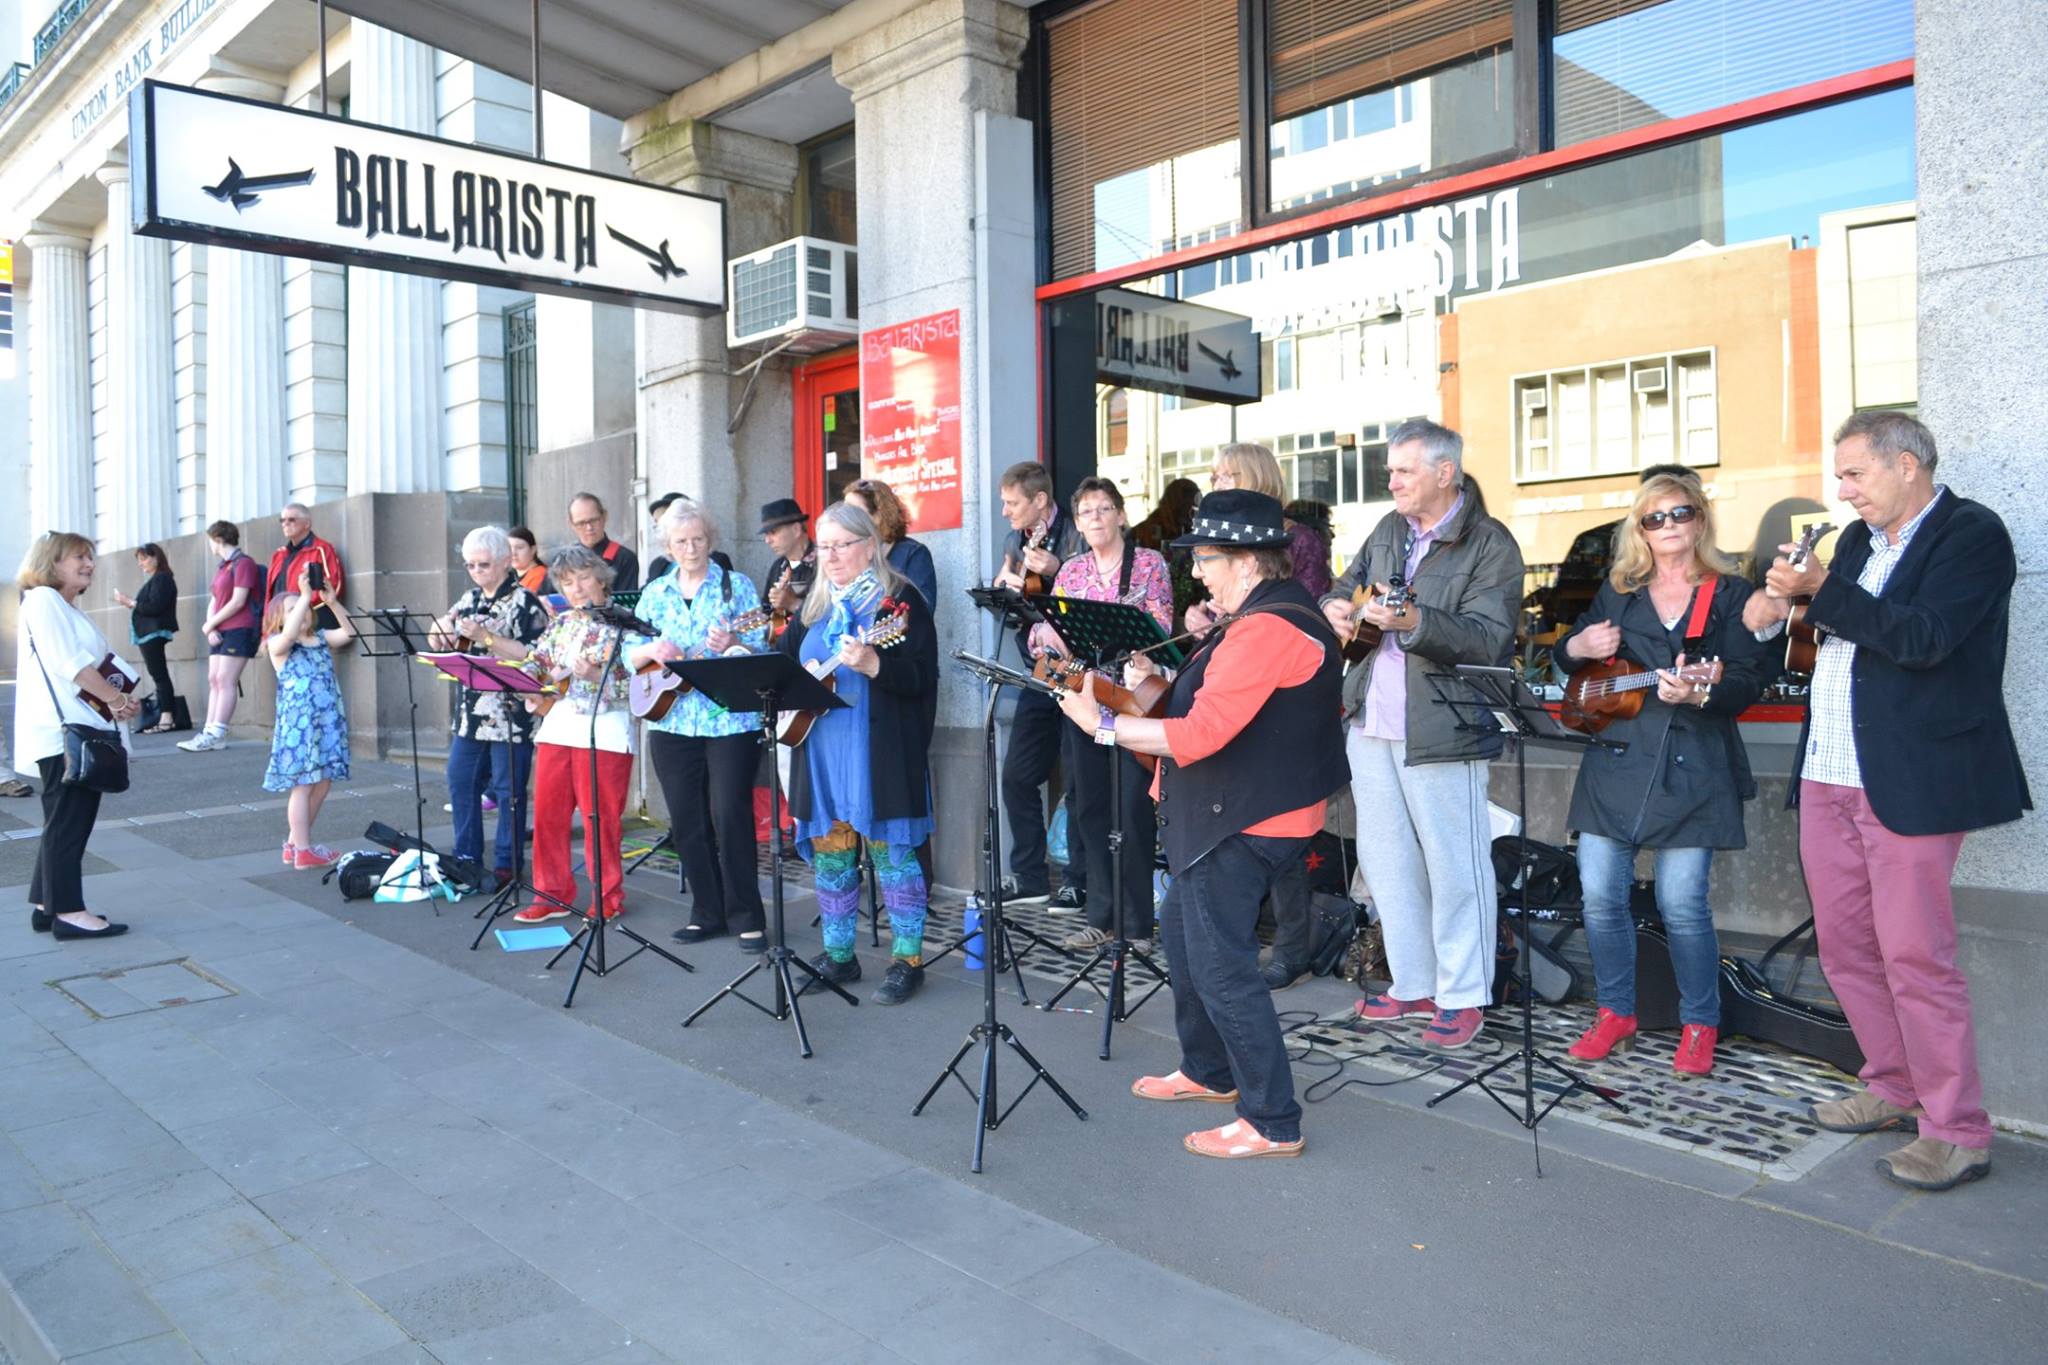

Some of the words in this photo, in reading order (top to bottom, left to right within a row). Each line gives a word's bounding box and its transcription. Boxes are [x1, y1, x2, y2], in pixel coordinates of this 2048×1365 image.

[72, 83, 108, 139] UNION
[115, 38, 152, 99] BANK
[335, 146, 598, 273] BALLARISTA
